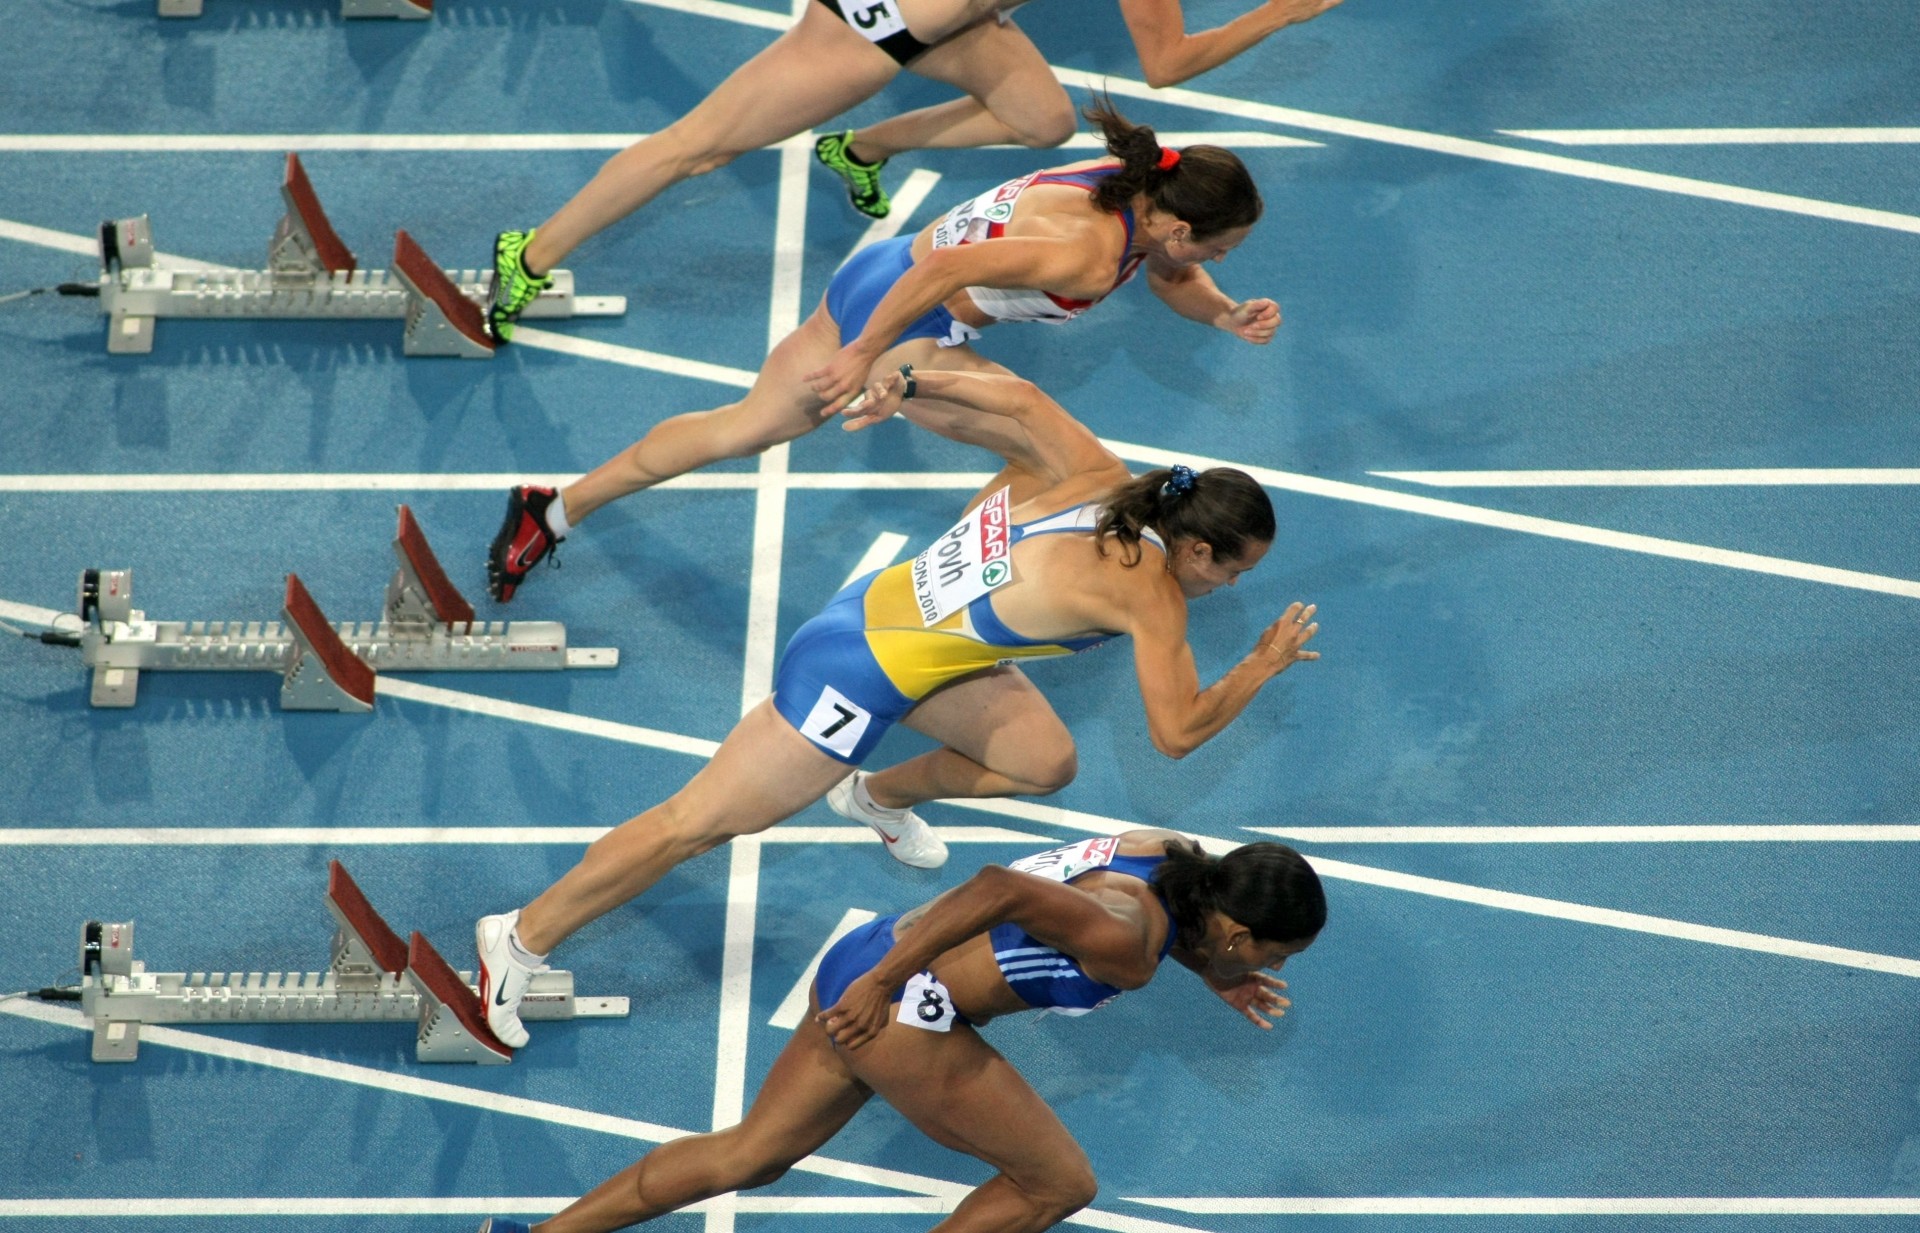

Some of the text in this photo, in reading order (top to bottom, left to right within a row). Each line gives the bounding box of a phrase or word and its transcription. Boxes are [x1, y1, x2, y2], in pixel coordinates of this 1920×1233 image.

[853, 2, 891, 29] 5
[984, 491, 1004, 561] SPAR
[938, 521, 971, 588] Povh
[919, 590, 938, 621] 2010
[820, 702, 857, 739] 7
[917, 989, 944, 1022] 8
